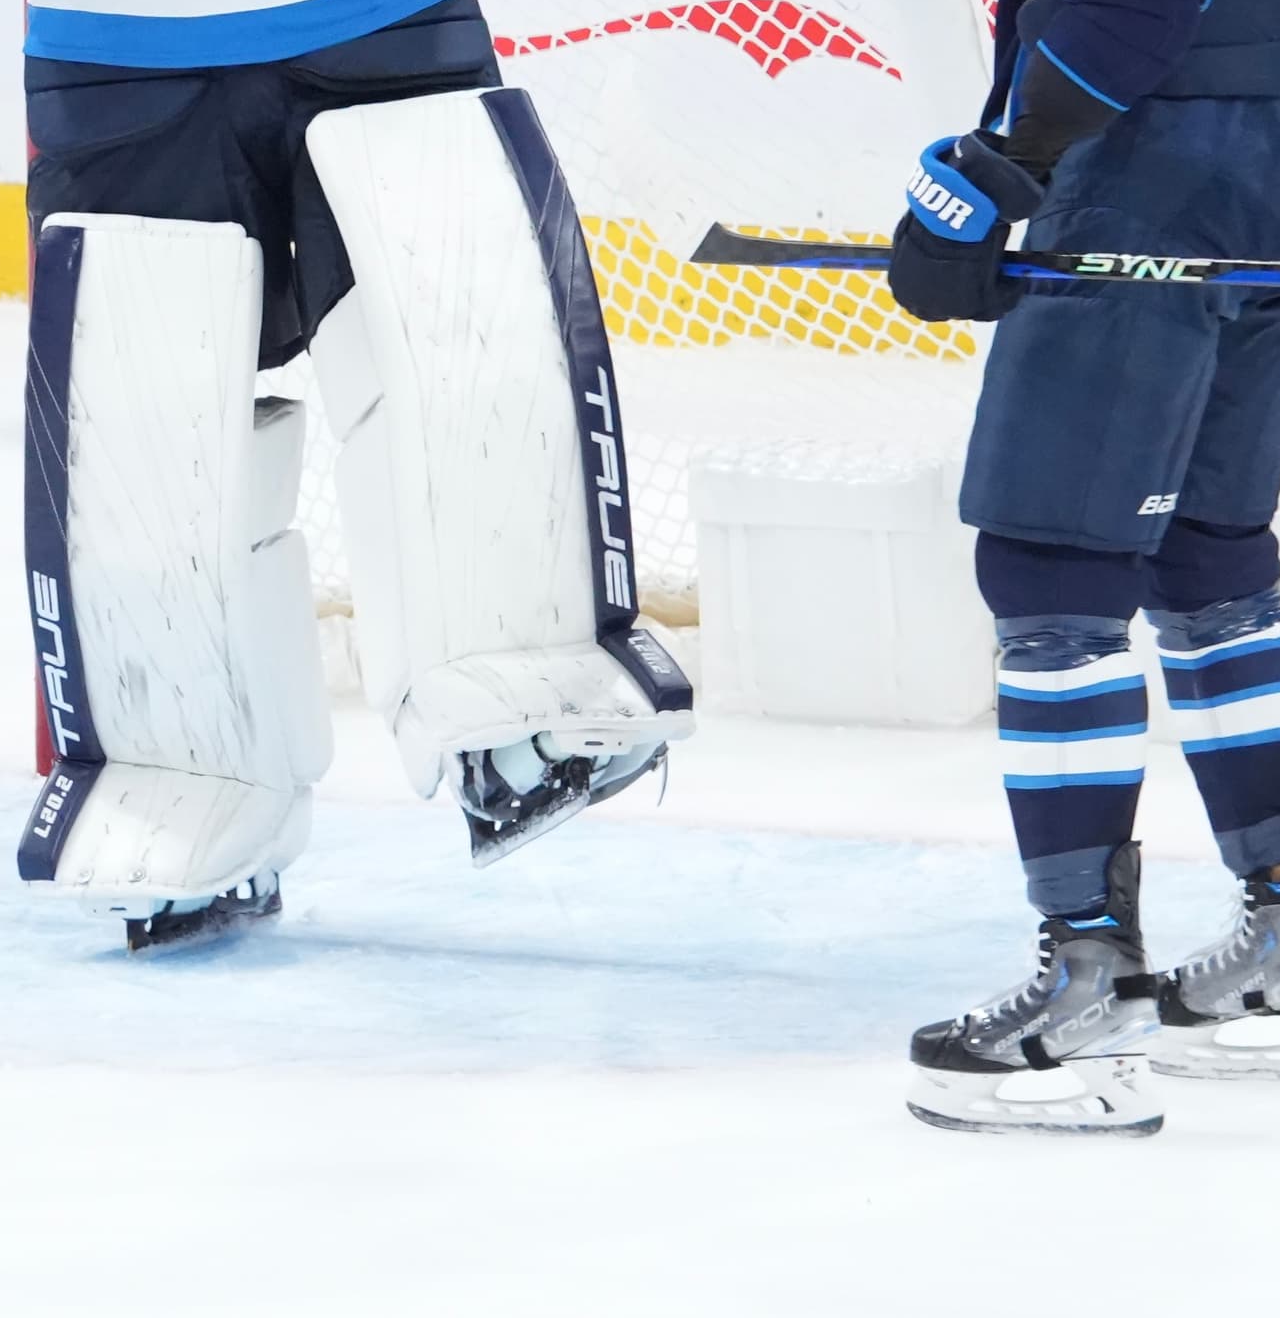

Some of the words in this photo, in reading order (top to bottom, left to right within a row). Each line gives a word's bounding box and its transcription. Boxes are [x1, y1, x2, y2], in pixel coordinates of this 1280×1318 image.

[1076, 253, 1212, 282] SYNC
[585, 365, 633, 610] TRUE
[33, 570, 81, 758] TRUE
[33, 774, 75, 839] L20.2
